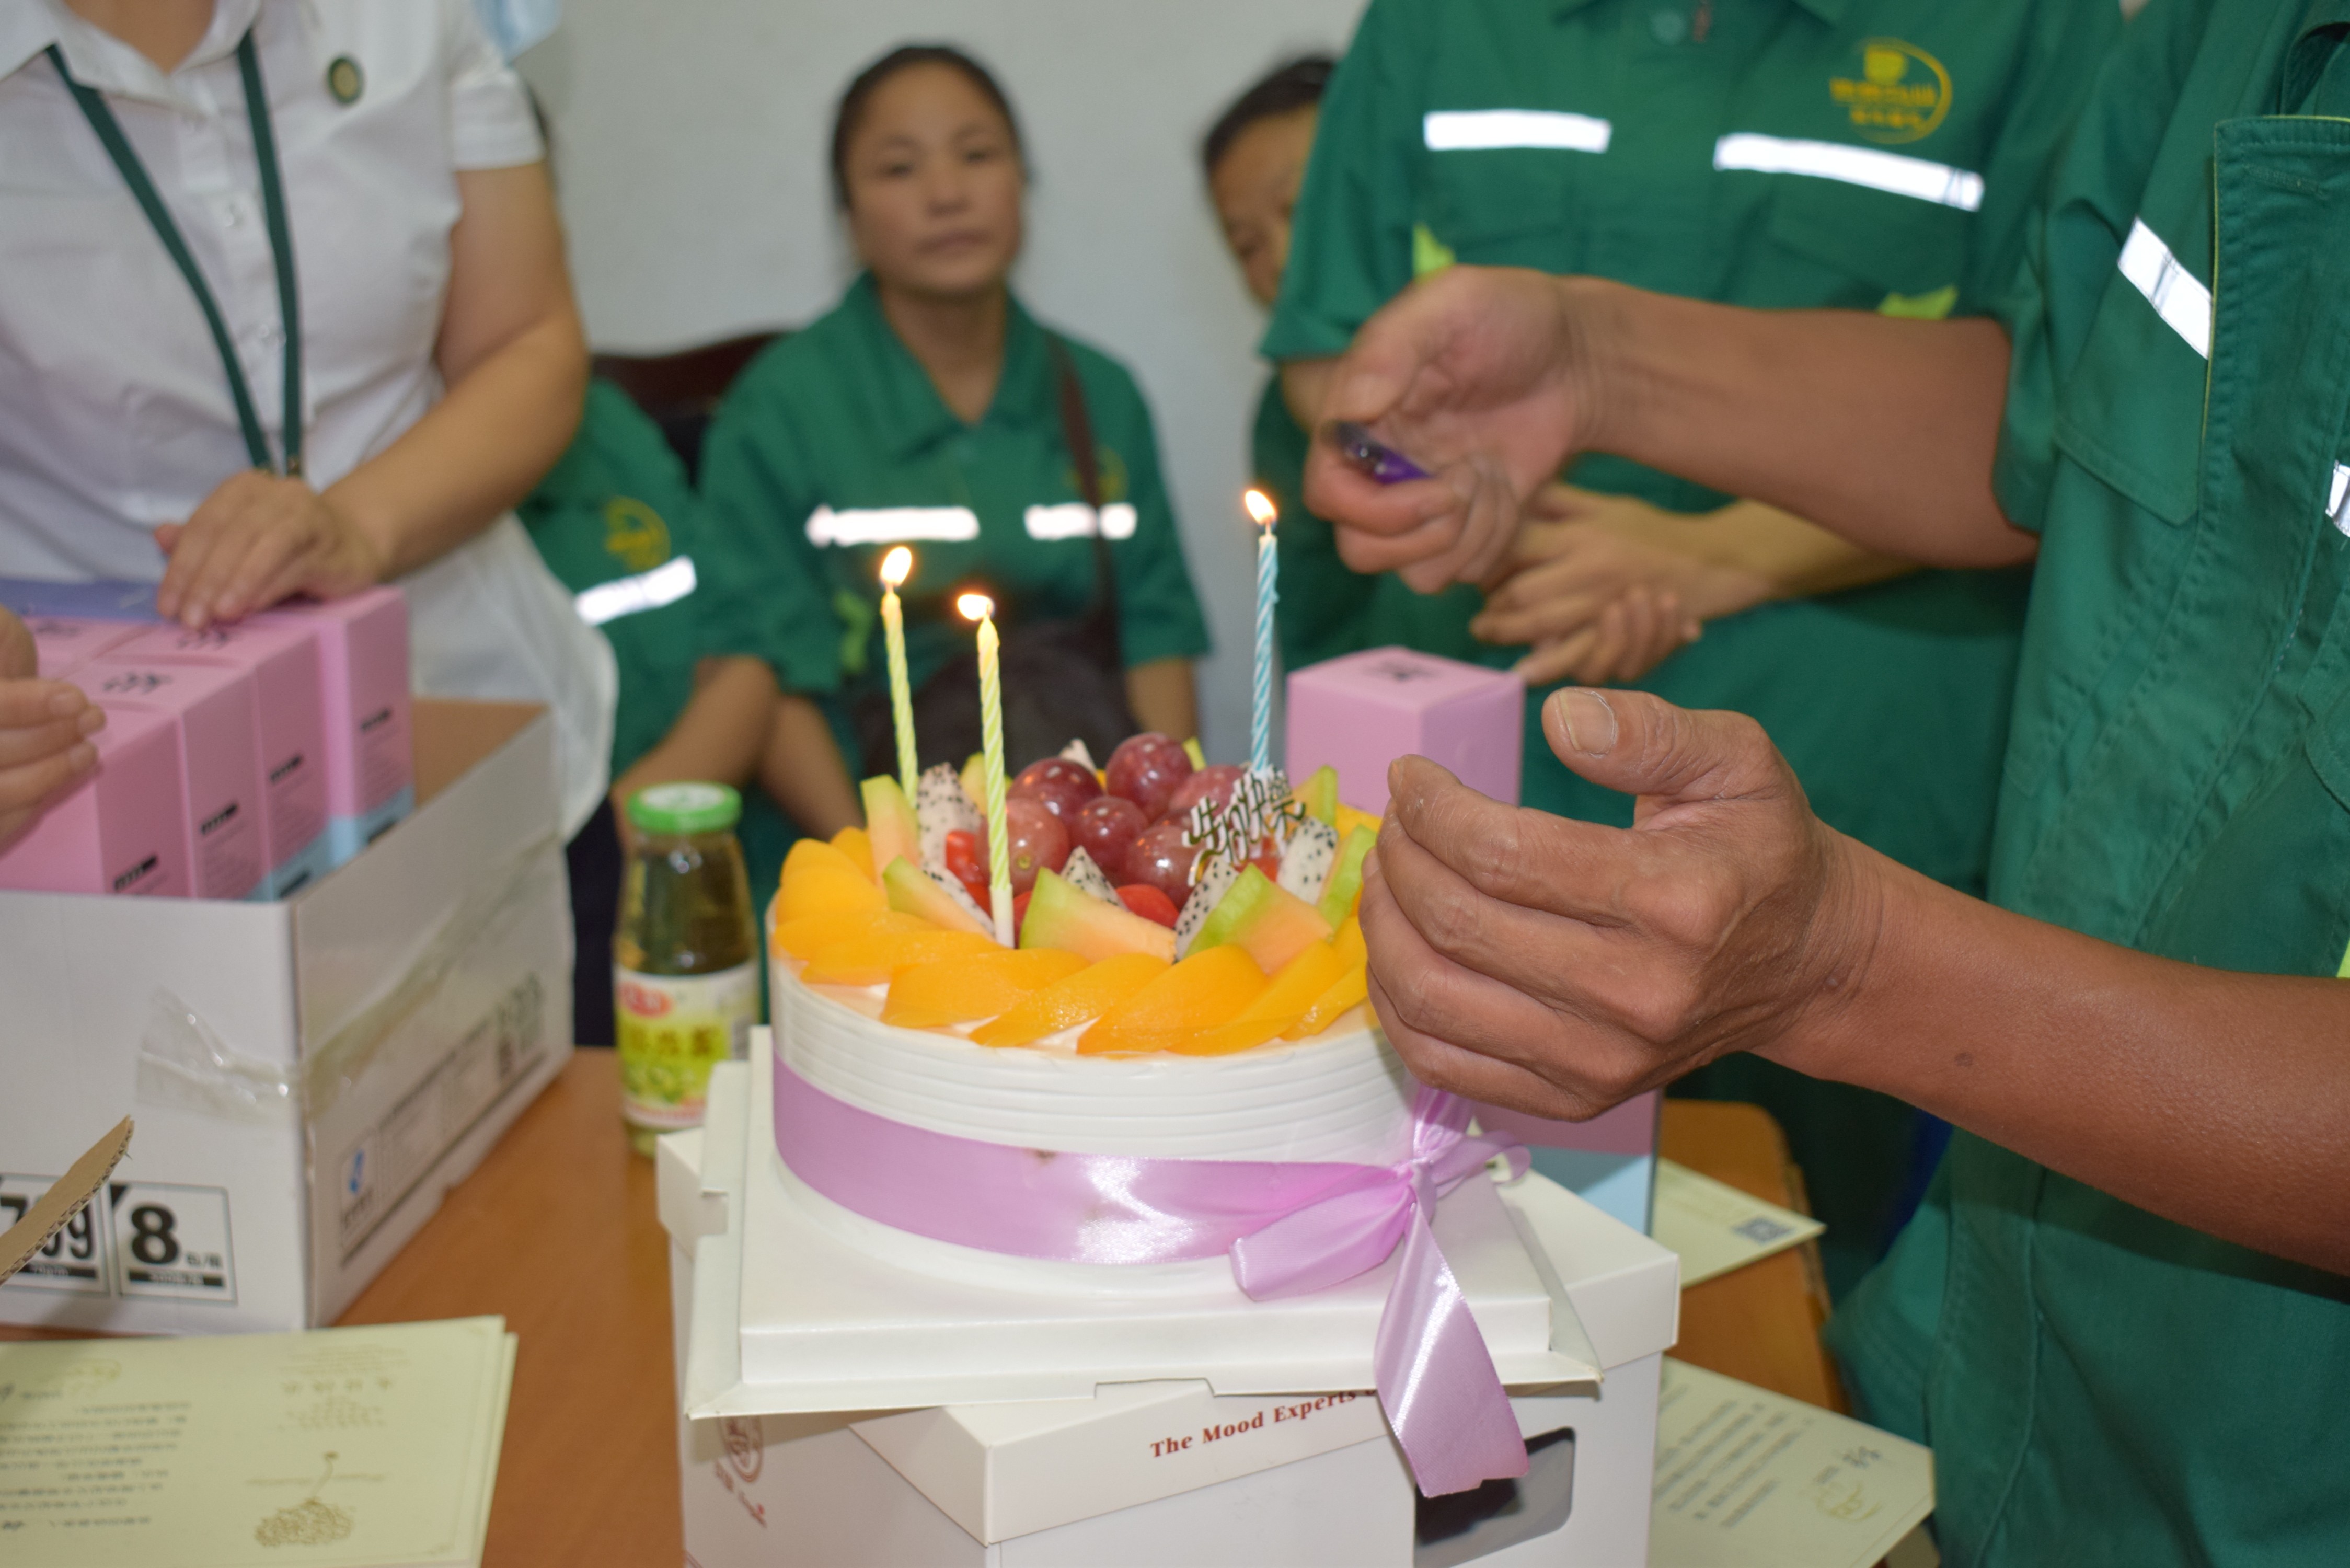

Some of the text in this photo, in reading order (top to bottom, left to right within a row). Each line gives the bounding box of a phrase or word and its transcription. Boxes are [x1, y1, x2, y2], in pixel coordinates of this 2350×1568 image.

[131, 1205, 180, 1264] 8
[1150, 1390, 1356, 1458] The Mood Experts
